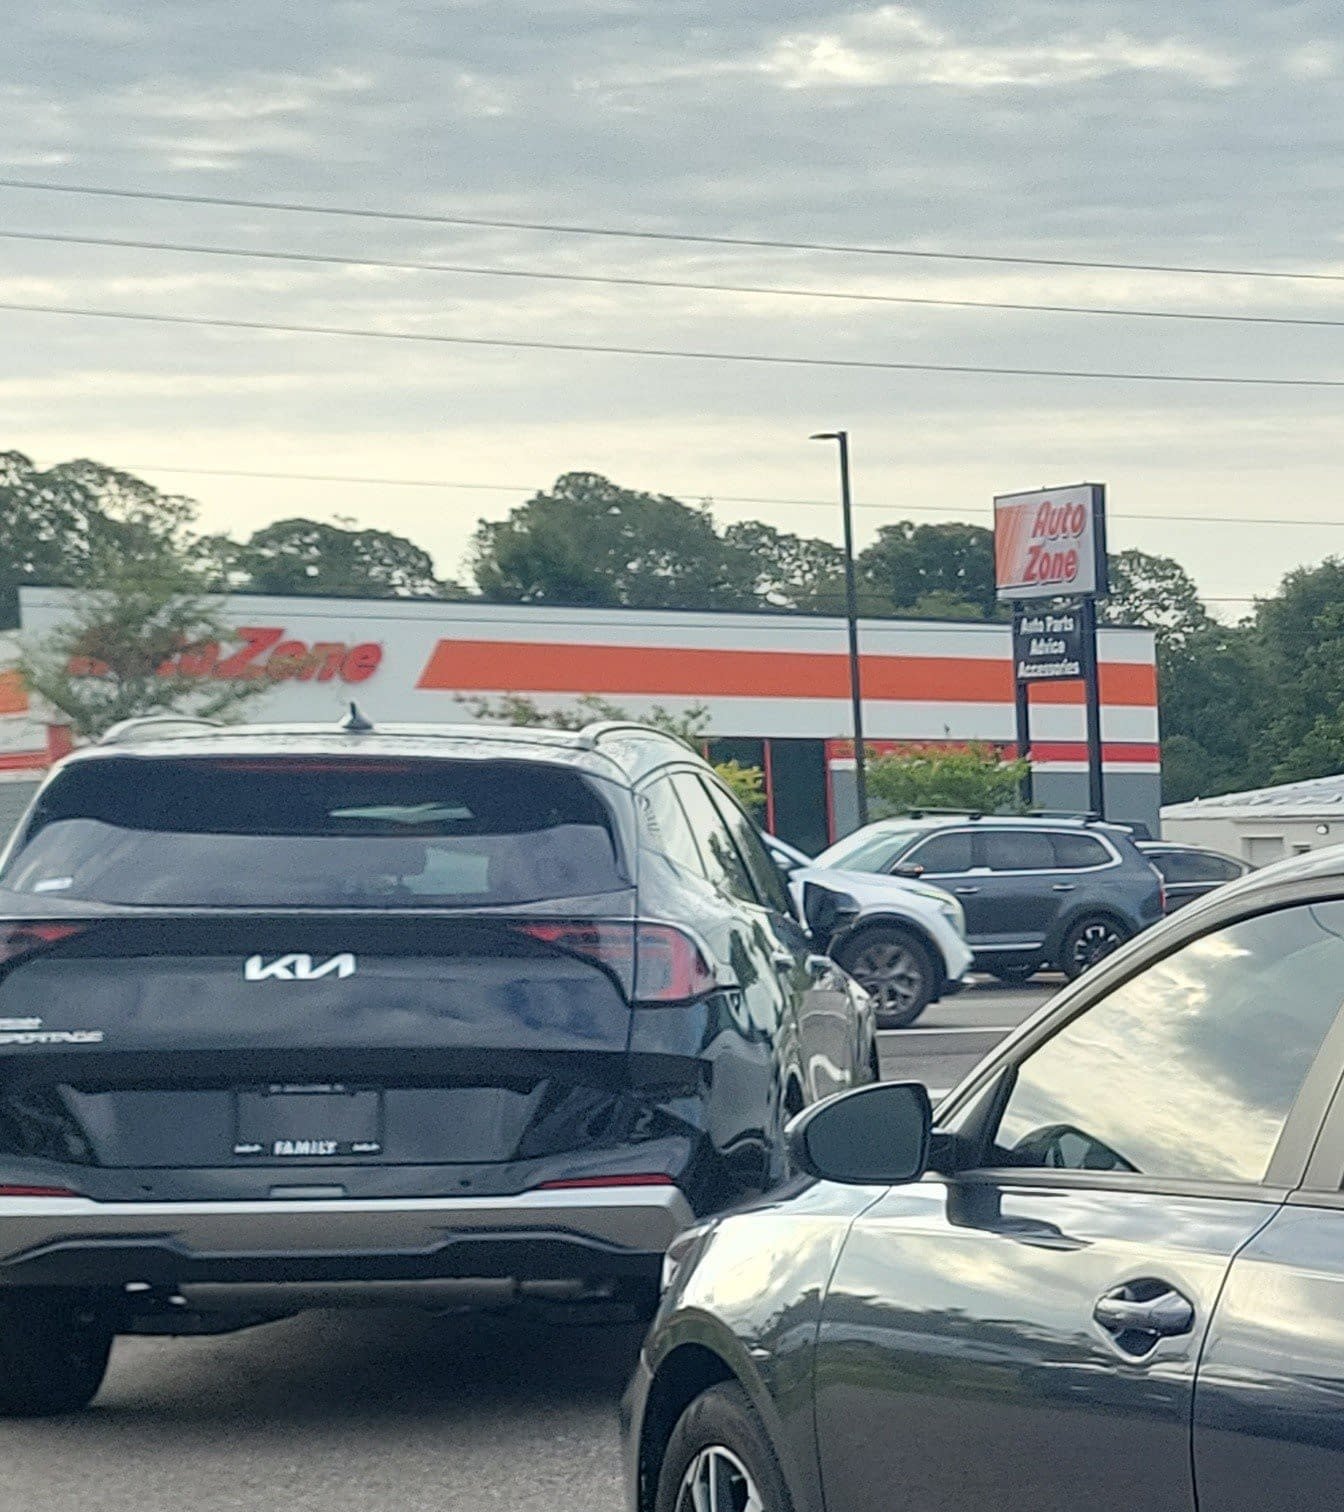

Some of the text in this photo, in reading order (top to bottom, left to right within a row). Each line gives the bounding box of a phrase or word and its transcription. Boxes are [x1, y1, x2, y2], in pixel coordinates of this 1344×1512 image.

[1032, 500, 1087, 540] Auto
[1023, 544, 1079, 584] Zone
[1020, 615, 1075, 635] Auto Parts
[245, 953, 356, 981] KIA
[274, 1140, 337, 1155] FAMILY
